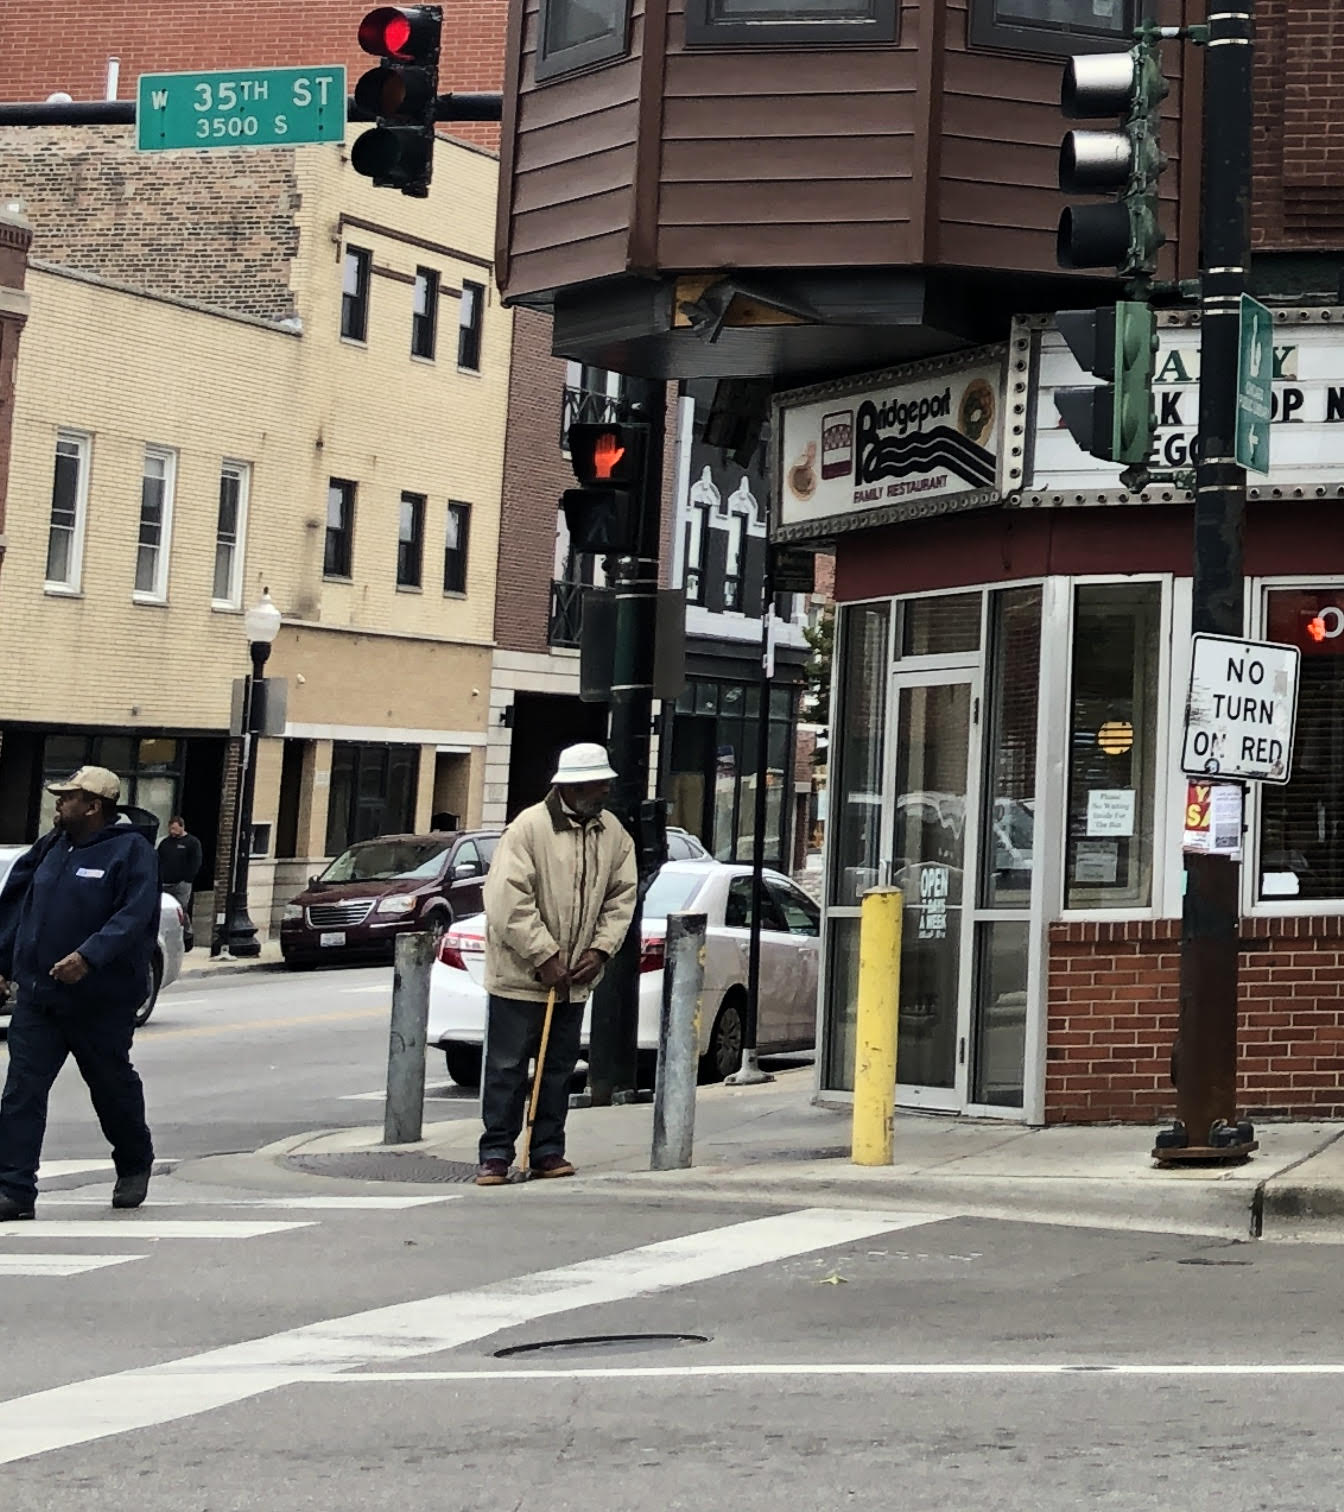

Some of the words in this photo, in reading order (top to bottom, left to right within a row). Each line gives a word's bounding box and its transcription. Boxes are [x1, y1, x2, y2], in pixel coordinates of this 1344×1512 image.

[152, 90, 168, 110] W
[193, 80, 268, 112] 35TH
[293, 76, 333, 107] ST
[196, 116, 258, 138] 3500
[274, 115, 288, 135] S
[855, 387, 951, 486] Bridgeport
[853, 487, 883, 503] FAMILY
[887, 475, 947, 497] RESTAURANT
[1227, 657, 1264, 685] NO
[1213, 694, 1274, 725] TURN
[1241, 735, 1282, 764] RED
[920, 868, 949, 897] OPEN
